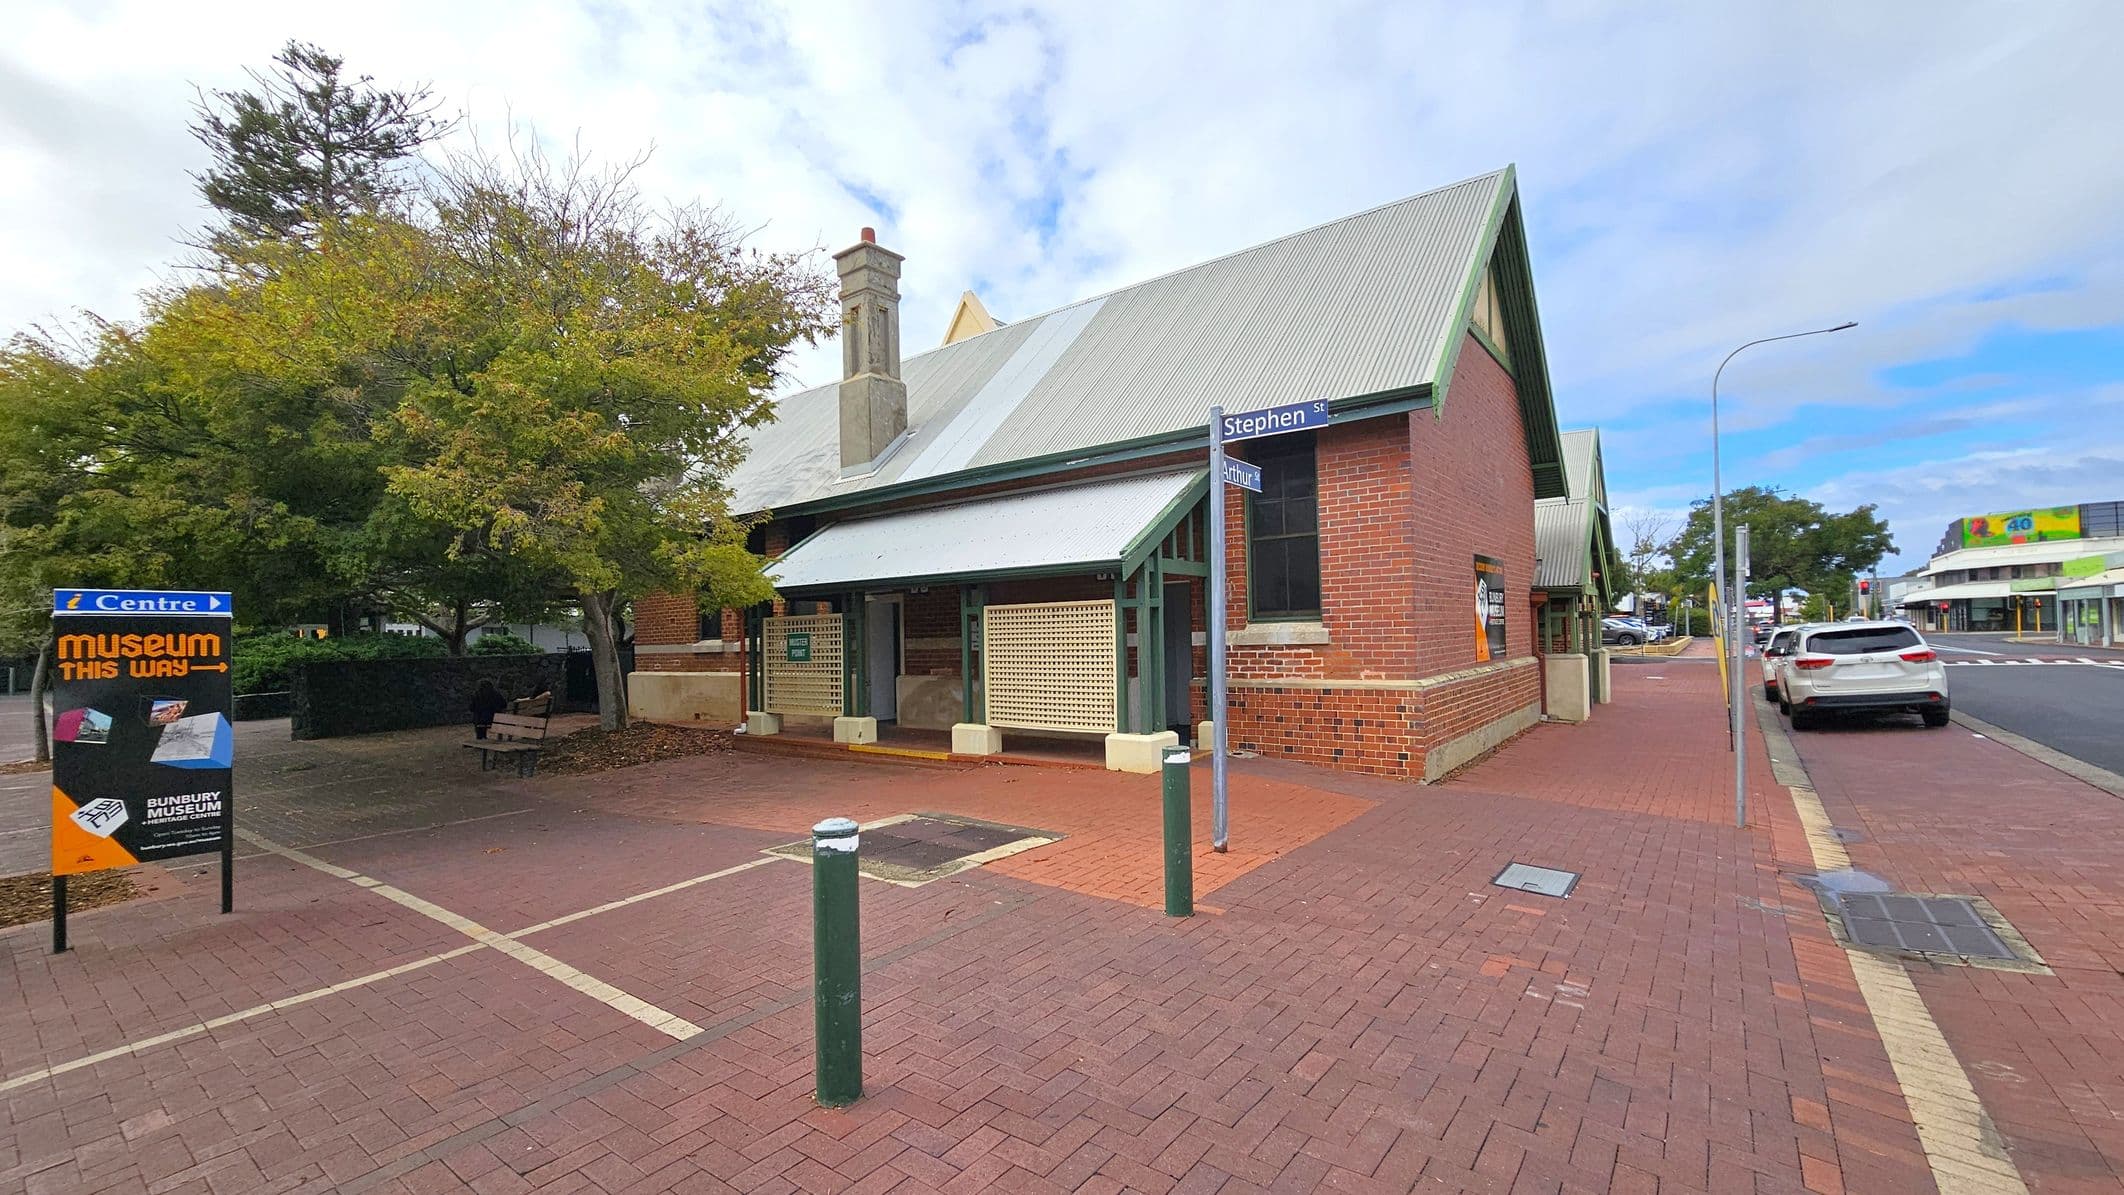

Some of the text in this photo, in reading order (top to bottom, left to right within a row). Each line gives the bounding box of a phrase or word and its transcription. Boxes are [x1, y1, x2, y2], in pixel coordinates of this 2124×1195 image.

[1224, 403, 1325, 435] Stephen St
[1223, 461, 1252, 486] Arthur
[2007, 518, 2032, 531] 40
[95, 595, 196, 611] Centre
[58, 659, 188, 680] THIS WAY
[147, 791, 221, 808] BUNBURY
[147, 801, 222, 818] MUSEUM
[189, 811, 222, 820] CENTRE
